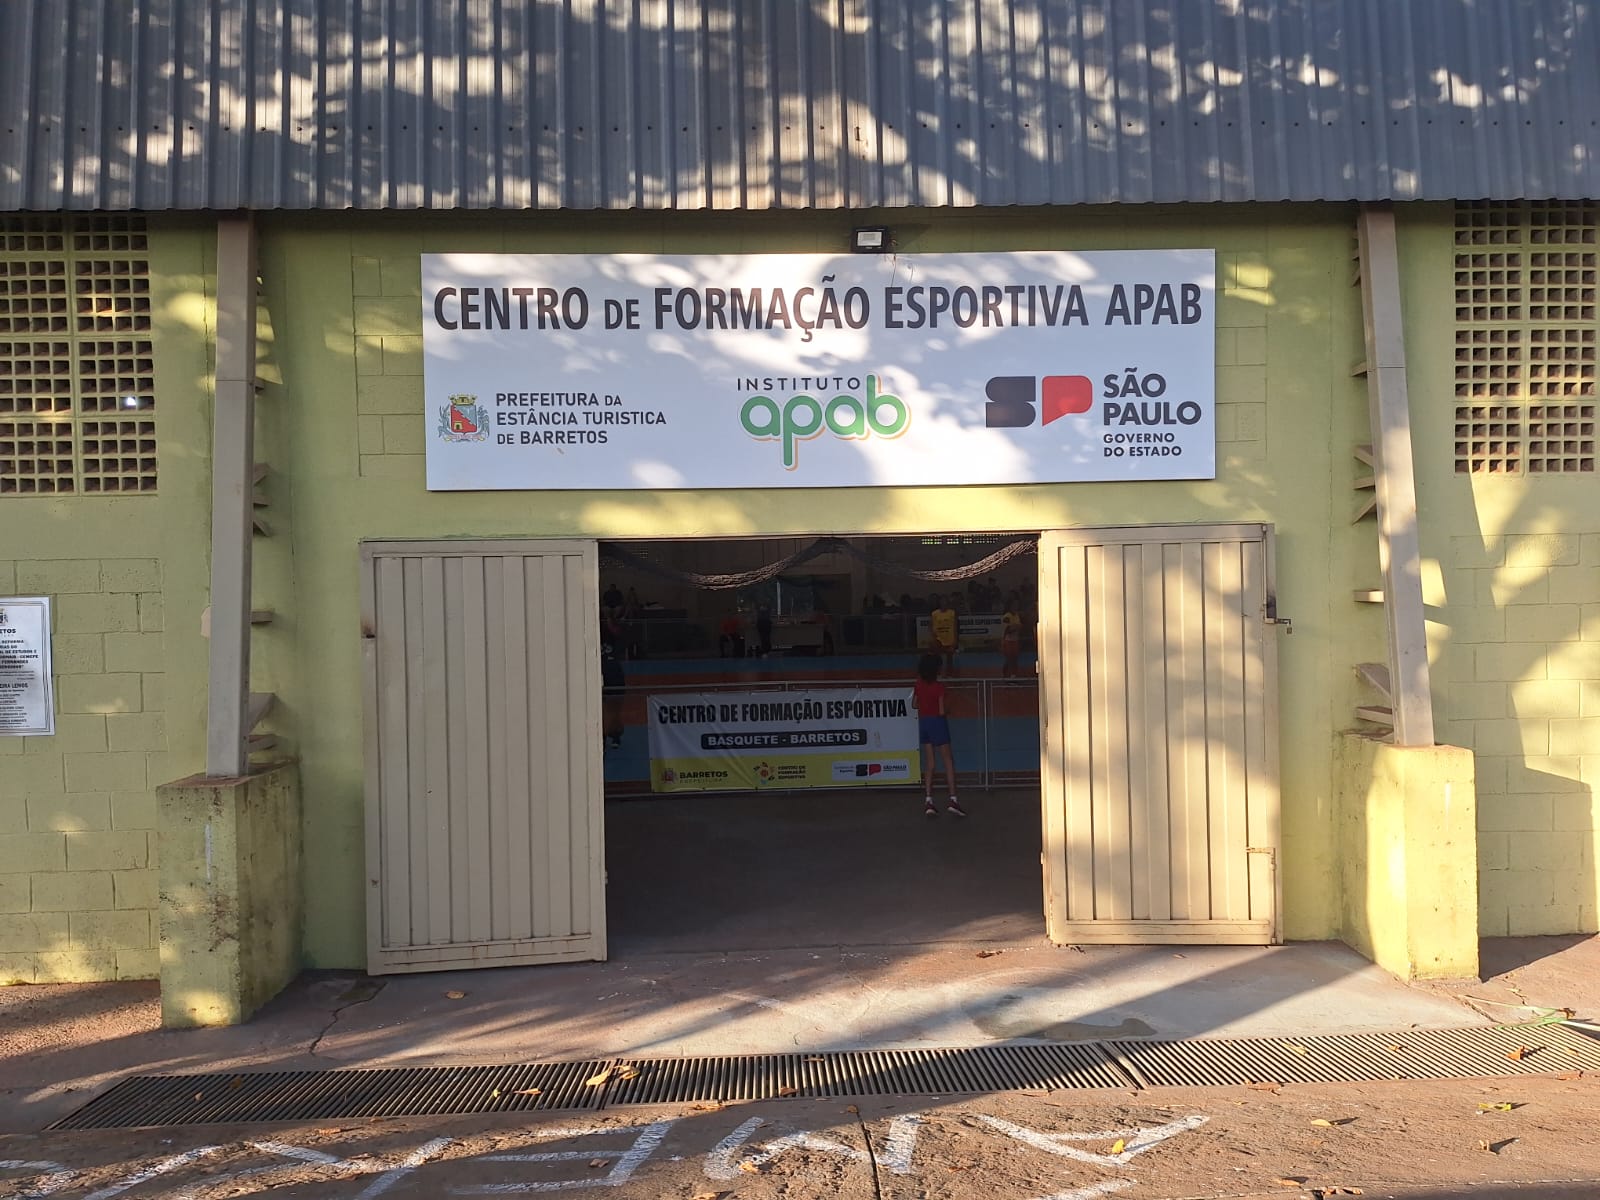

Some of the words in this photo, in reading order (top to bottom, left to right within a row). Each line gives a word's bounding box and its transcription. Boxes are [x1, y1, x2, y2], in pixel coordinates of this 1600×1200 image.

[434, 286, 589, 330] CENTRO
[604, 299, 640, 330] DE
[654, 274, 870, 343] FORMAÇÃO
[884, 284, 1089, 329] ESPORTIVA
[1104, 283, 1202, 326] APAB
[737, 377, 861, 391] INSTITUTO
[1103, 367, 1167, 398] SÃO
[496, 392, 599, 407] PREFEITURA
[604, 395, 623, 407] DA
[496, 408, 578, 426] ESTÂNCIA
[583, 411, 667, 425] TURISTICA
[1103, 400, 1202, 426] PAULO
[738, 374, 909, 470] apab
[497, 432, 515, 445] DE
[520, 430, 608, 445] BARRETOS
[1103, 432, 1175, 444] GOVERNO
[1103, 446, 1125, 457] DO
[1129, 445, 1182, 457] ESTADO
[658, 704, 716, 724] CENTRO
[720, 704, 739, 722] DE
[742, 699, 822, 724] FORMAÇÃO
[827, 699, 907, 719] ESPORTIVA
[708, 734, 779, 747] BASQUETE
[790, 732, 860, 744] BARRETOS
[680, 771, 729, 779] BARRETOS
